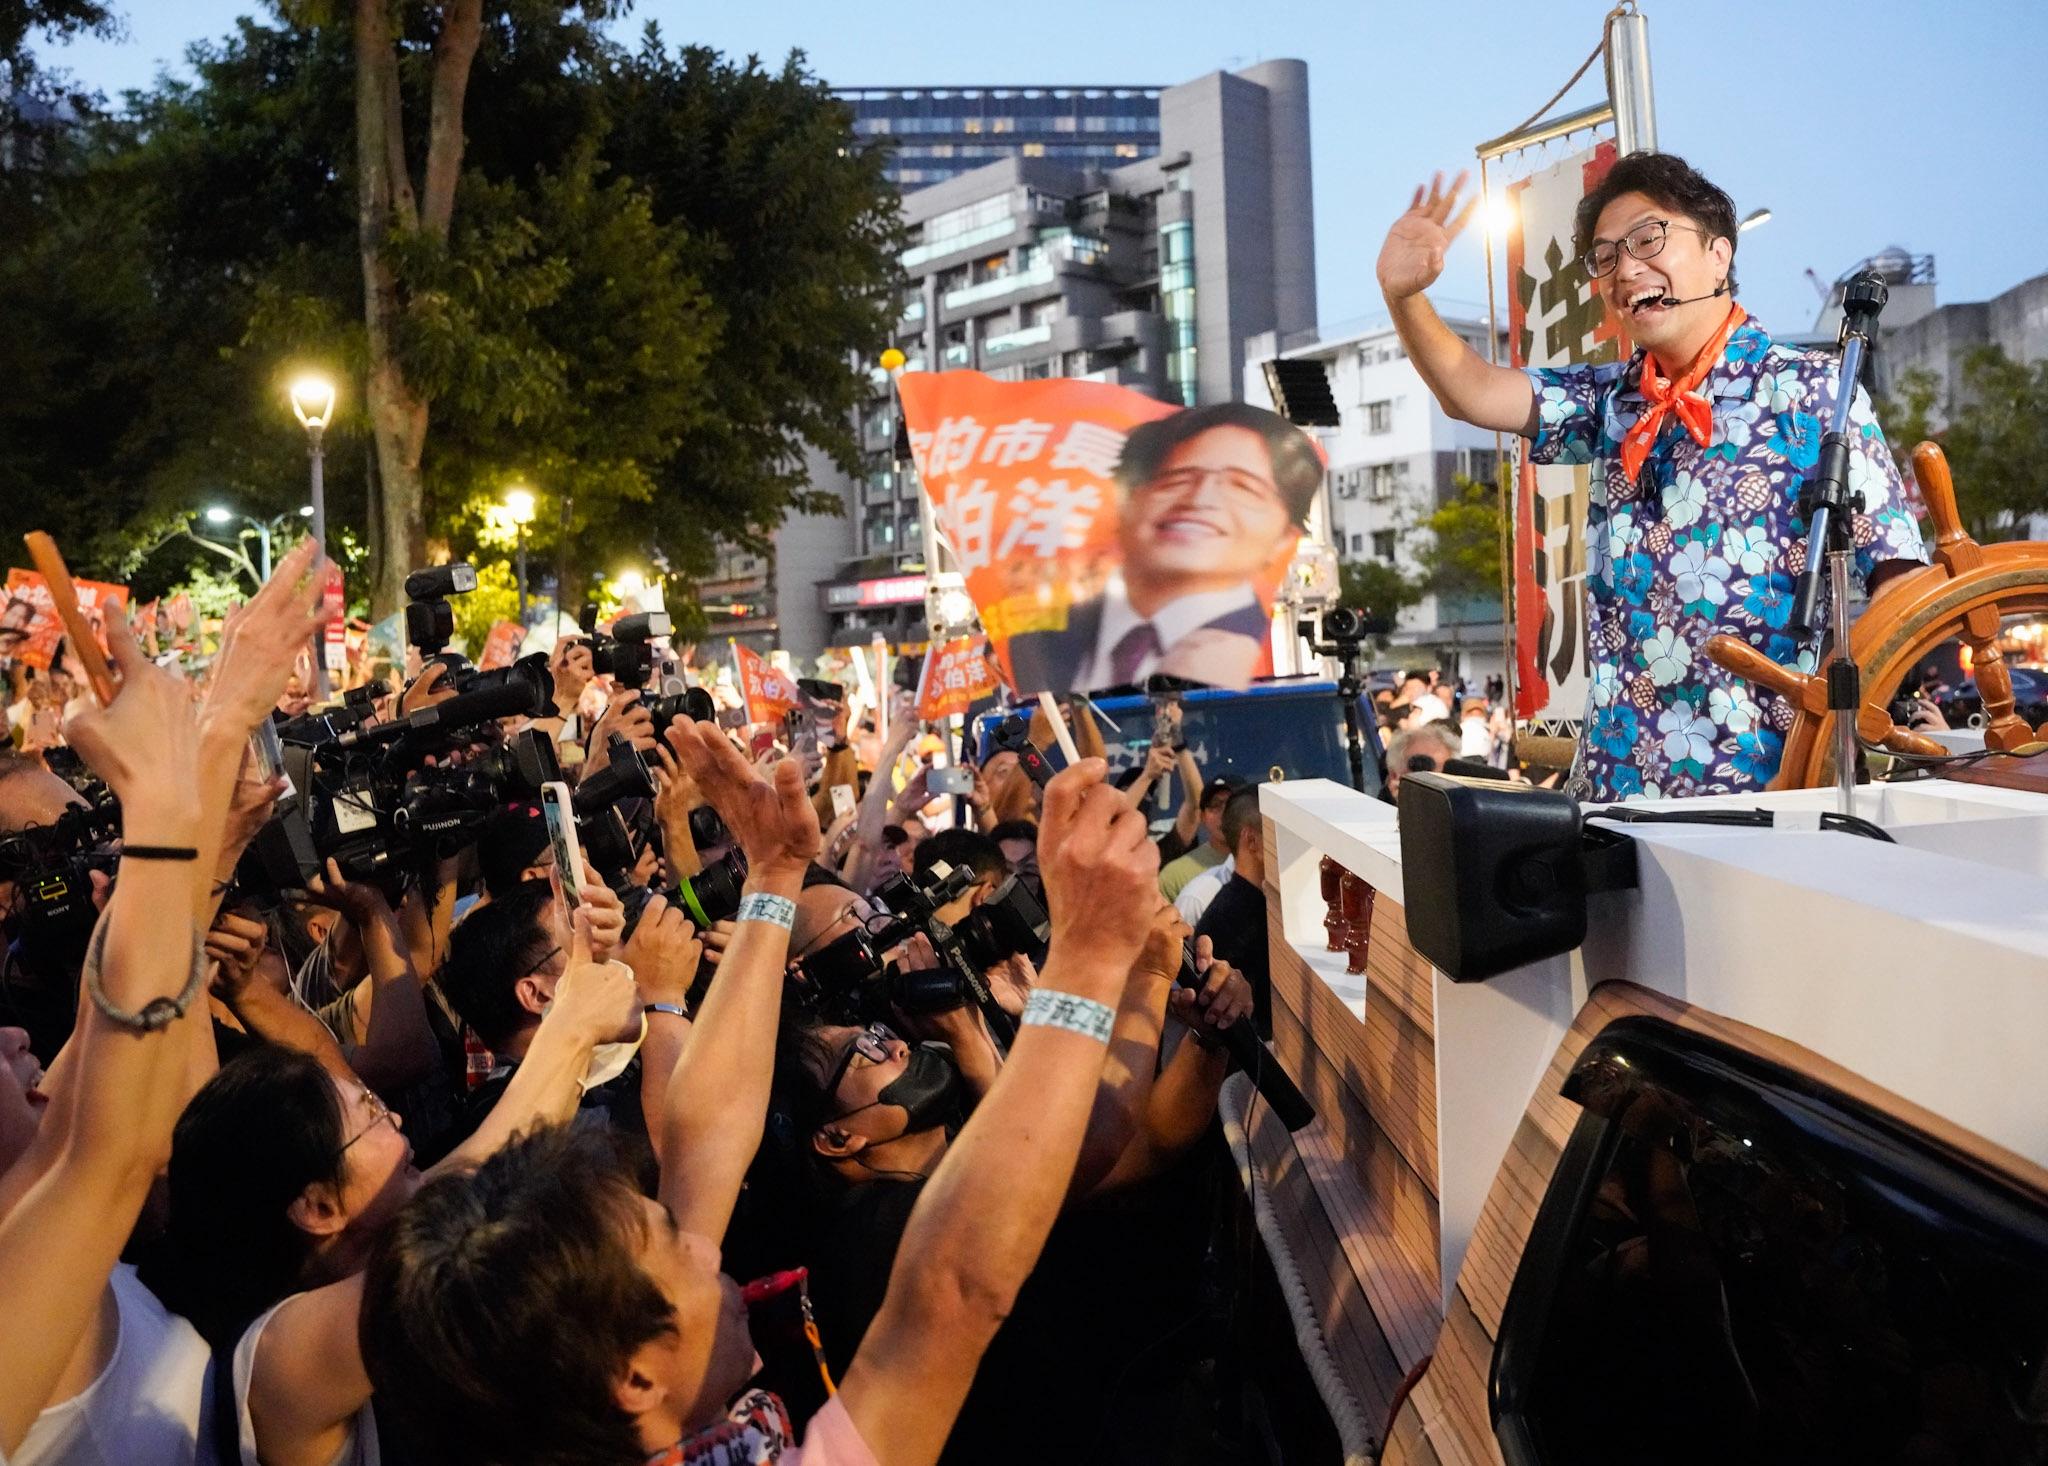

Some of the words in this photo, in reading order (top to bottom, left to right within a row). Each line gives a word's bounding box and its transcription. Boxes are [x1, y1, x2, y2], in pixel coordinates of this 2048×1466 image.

[422, 818, 461, 831] FUJINON
[47, 904, 70, 917] SONY
[950, 946, 988, 1004] Panasonic
